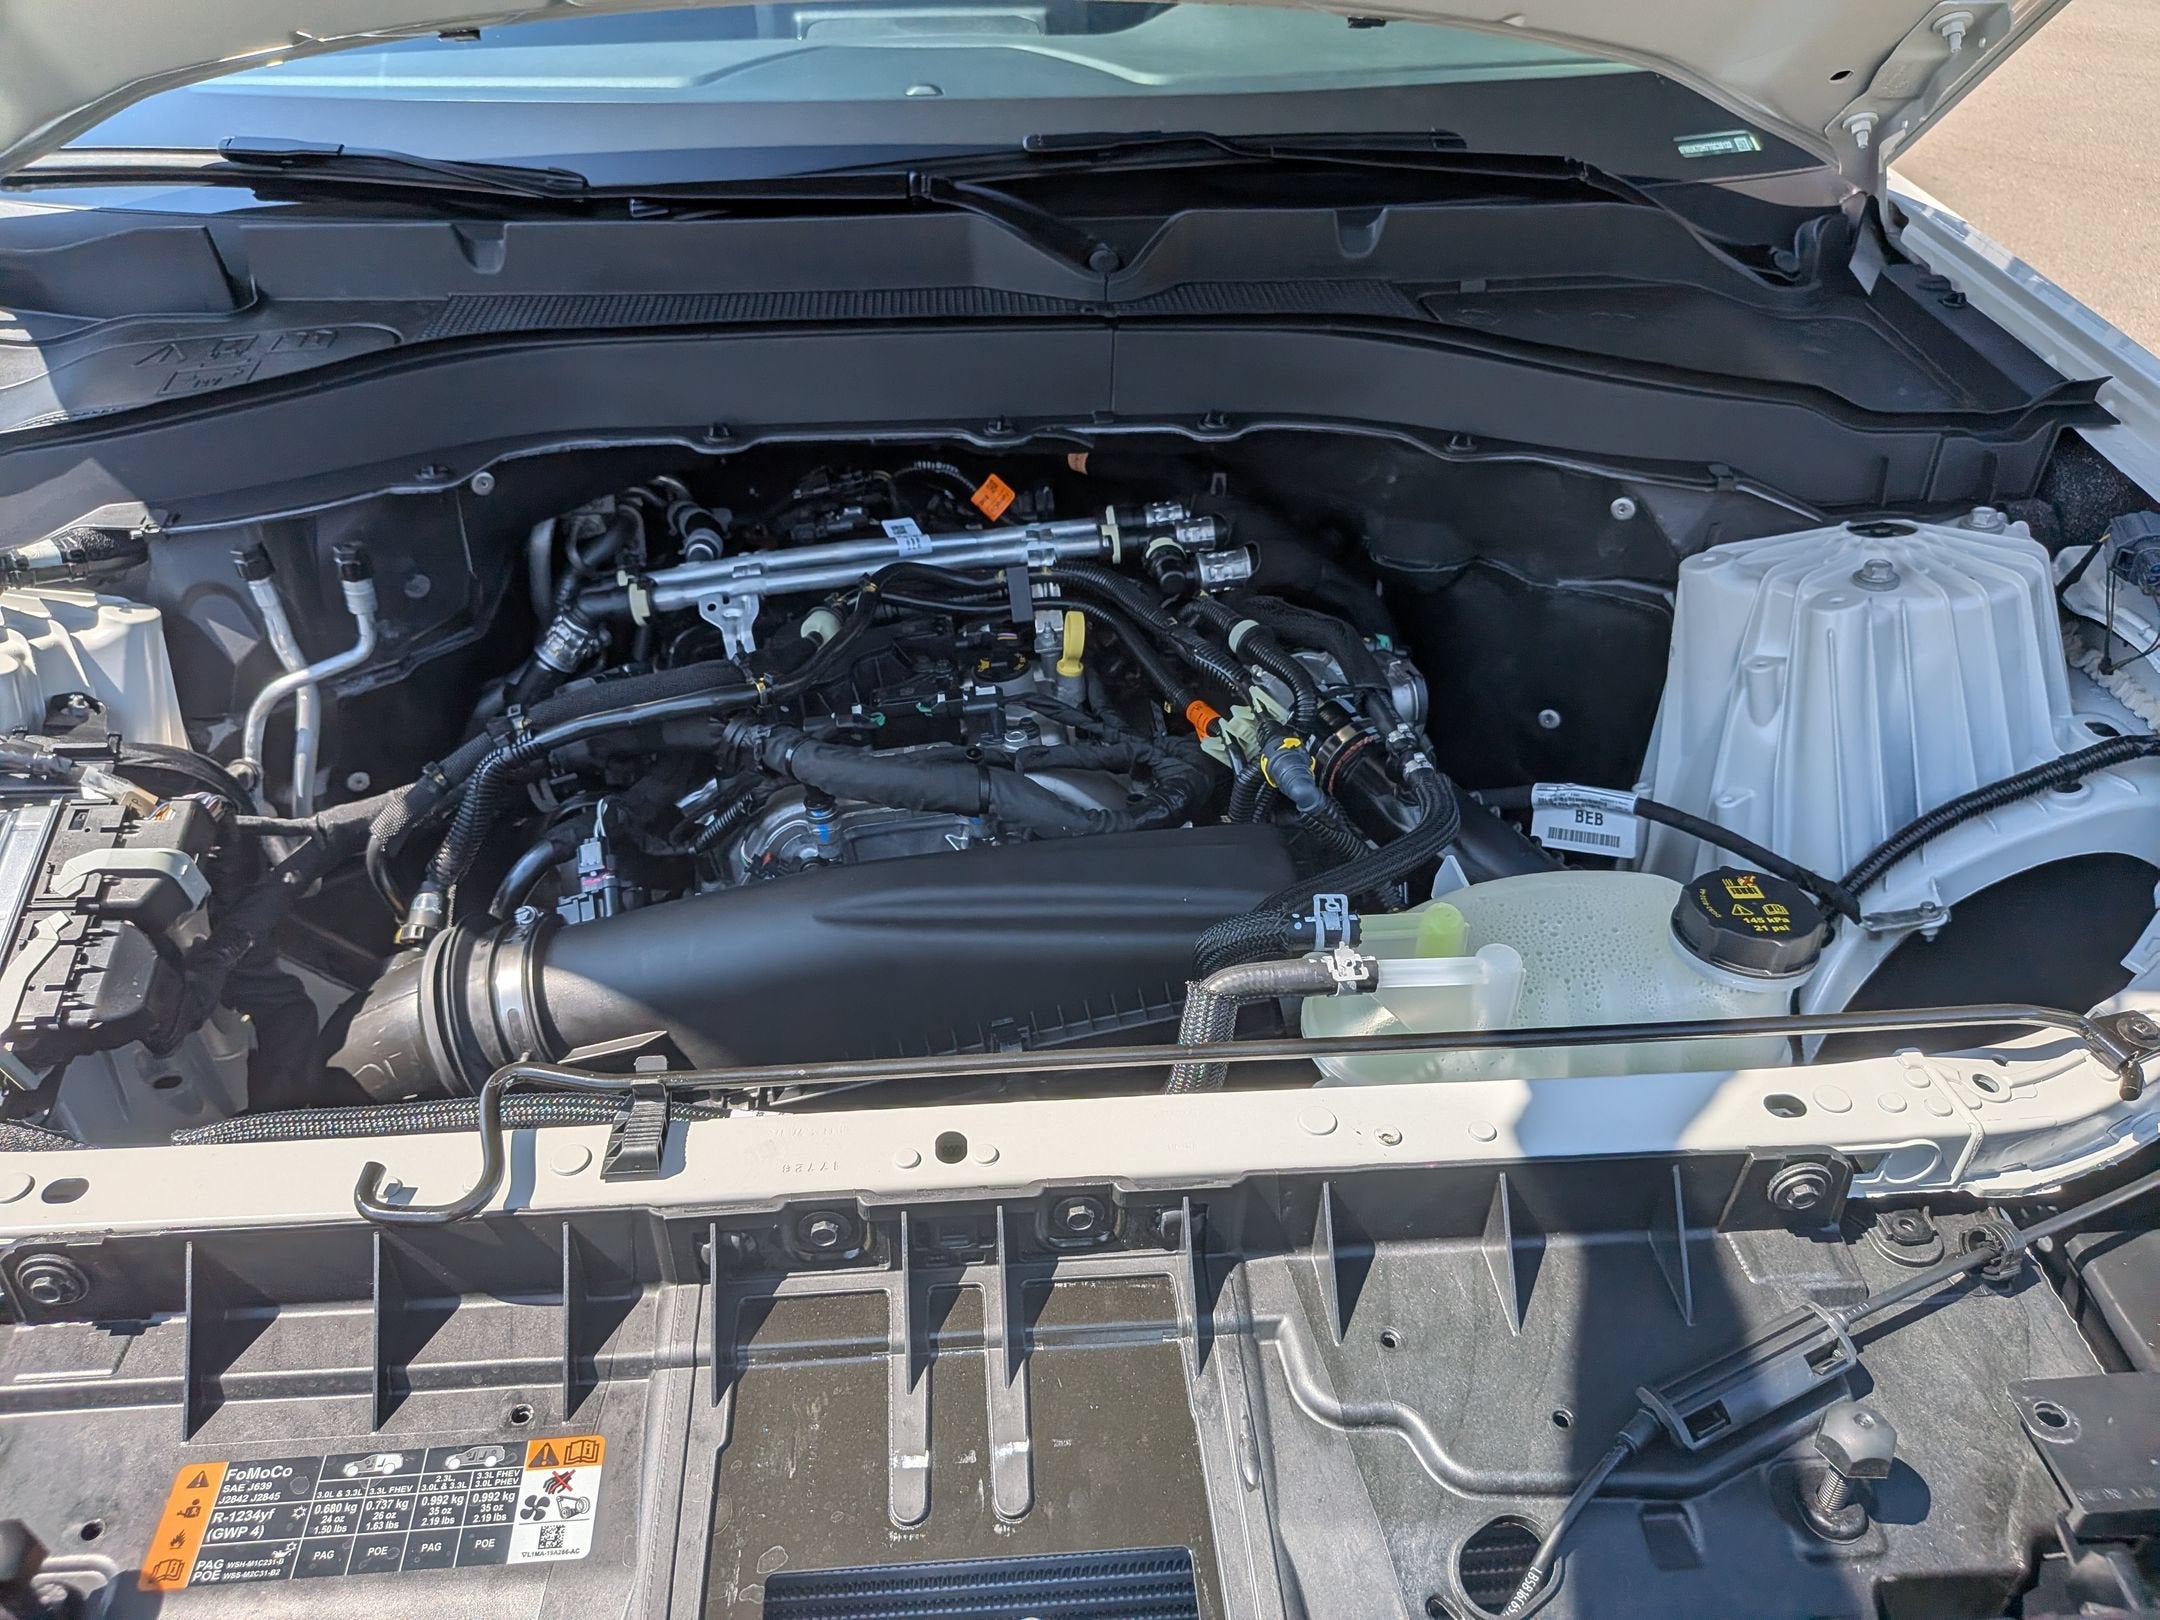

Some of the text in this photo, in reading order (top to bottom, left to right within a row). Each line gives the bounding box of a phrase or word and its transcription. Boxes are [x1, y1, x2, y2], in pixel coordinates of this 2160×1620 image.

[1574, 809, 1604, 826] BEB
[1772, 925, 1791, 933] psi
[225, 1465, 293, 1481] FoMoCo
[476, 1469, 521, 1480] 3.3L FHEV
[222, 1481, 273, 1493] SAE J639
[421, 1481, 467, 1491] 3.0L & 3.3L
[475, 1477, 519, 1488] 3.0L PHEV
[316, 1490, 334, 1499] 3.0L
[344, 1488, 363, 1497] 3.3L
[369, 1484, 414, 1495] 3.3L FHEV
[217, 1492, 281, 1505] J2842 J2845
[421, 1494, 465, 1506] 0.992 kg
[472, 1491, 516, 1503] 0.992 kg
[314, 1502, 358, 1515] 0.680 kg
[365, 1498, 409, 1511] 0.737 kg
[480, 1503, 504, 1513] 35 oz
[211, 1507, 276, 1524] R-1234yf
[372, 1511, 397, 1521] 26 oz
[428, 1506, 453, 1516] 35 oz
[320, 1514, 346, 1524] 24 oz
[420, 1516, 455, 1527] 2.19 lbs
[472, 1513, 507, 1523] 2.19 lbs
[313, 1524, 347, 1535] 1.50 lbs
[365, 1520, 399, 1531] 1.63 lbs
[205, 1524, 265, 1543] (GWP 4)
[420, 1542, 442, 1553] PAG
[474, 1538, 496, 1549] POE
[313, 1550, 335, 1560] PAG
[367, 1546, 389, 1556] POE
[195, 1558, 225, 1571] PAG
[191, 1569, 222, 1583] POE
[1502, 1566, 1543, 1617] LB5B16C65
